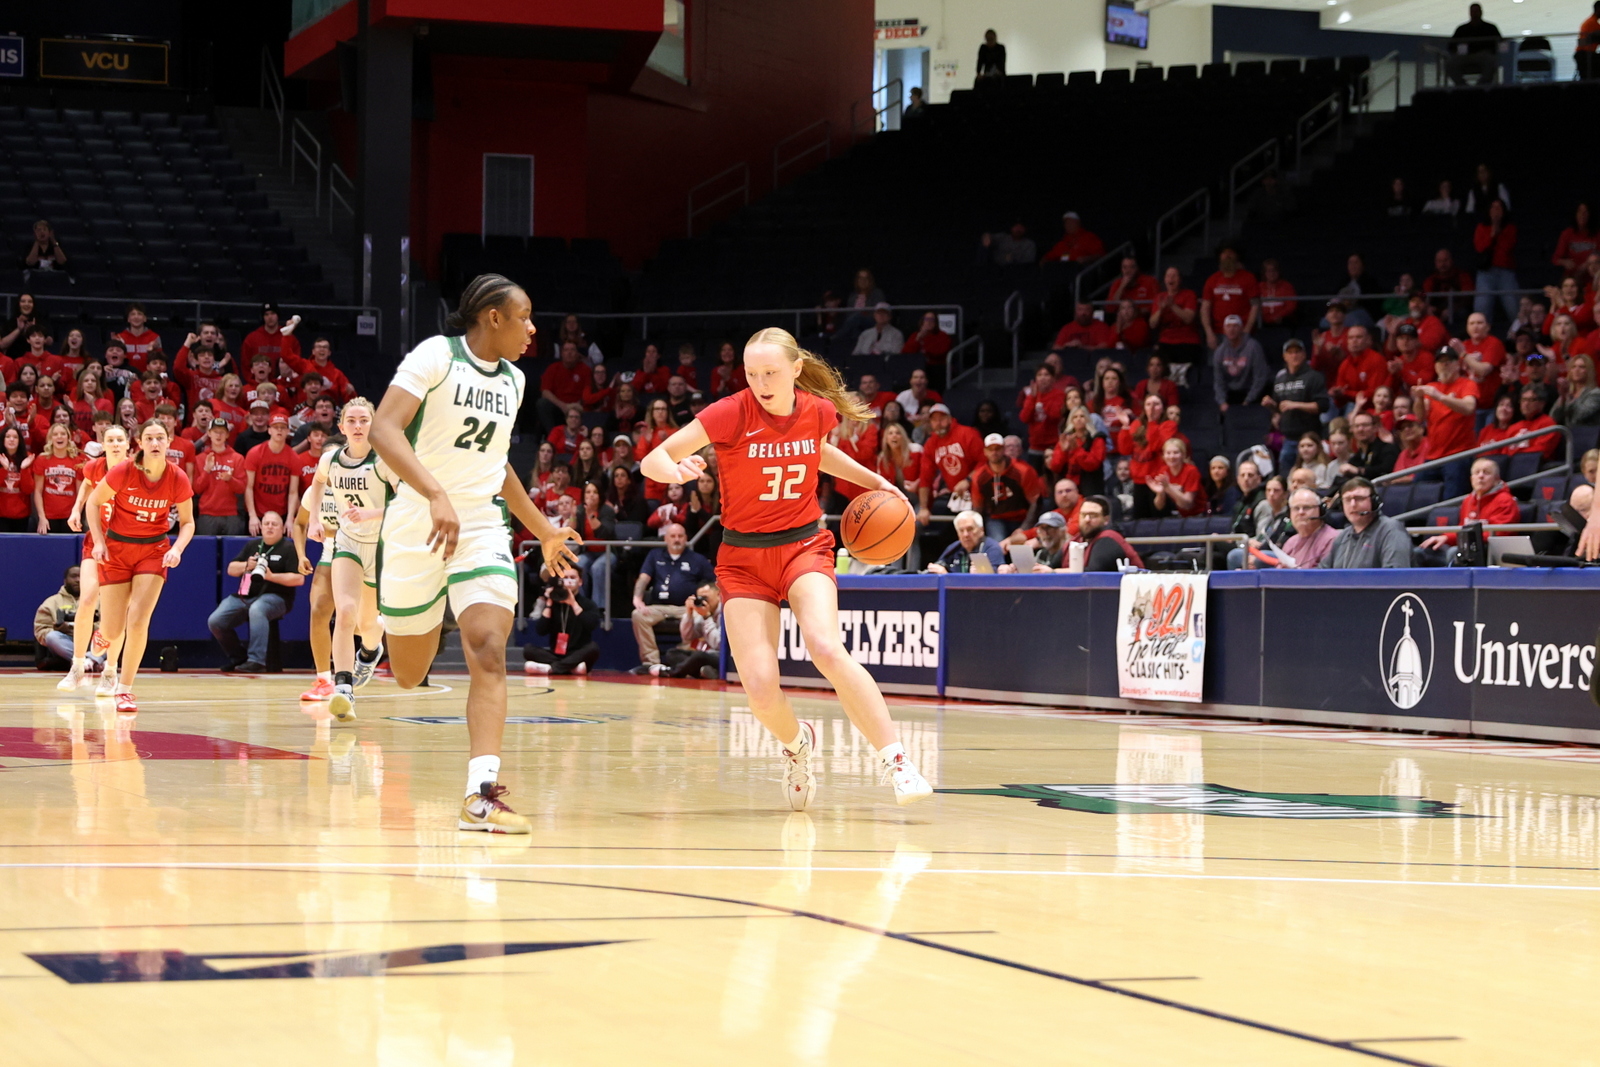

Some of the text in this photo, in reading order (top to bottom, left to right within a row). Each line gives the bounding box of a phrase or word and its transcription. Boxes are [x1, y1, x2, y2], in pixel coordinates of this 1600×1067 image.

[81, 51, 129, 71] VCU
[453, 383, 510, 417] LAUREL
[454, 416, 497, 453] 24
[748, 438, 817, 459] BELLEVUE
[334, 475, 369, 490] LAUREL
[759, 463, 808, 502] 32
[136, 510, 157, 522] 21
[321, 502, 339, 514] AURE
[838, 610, 940, 668] FLYERS
